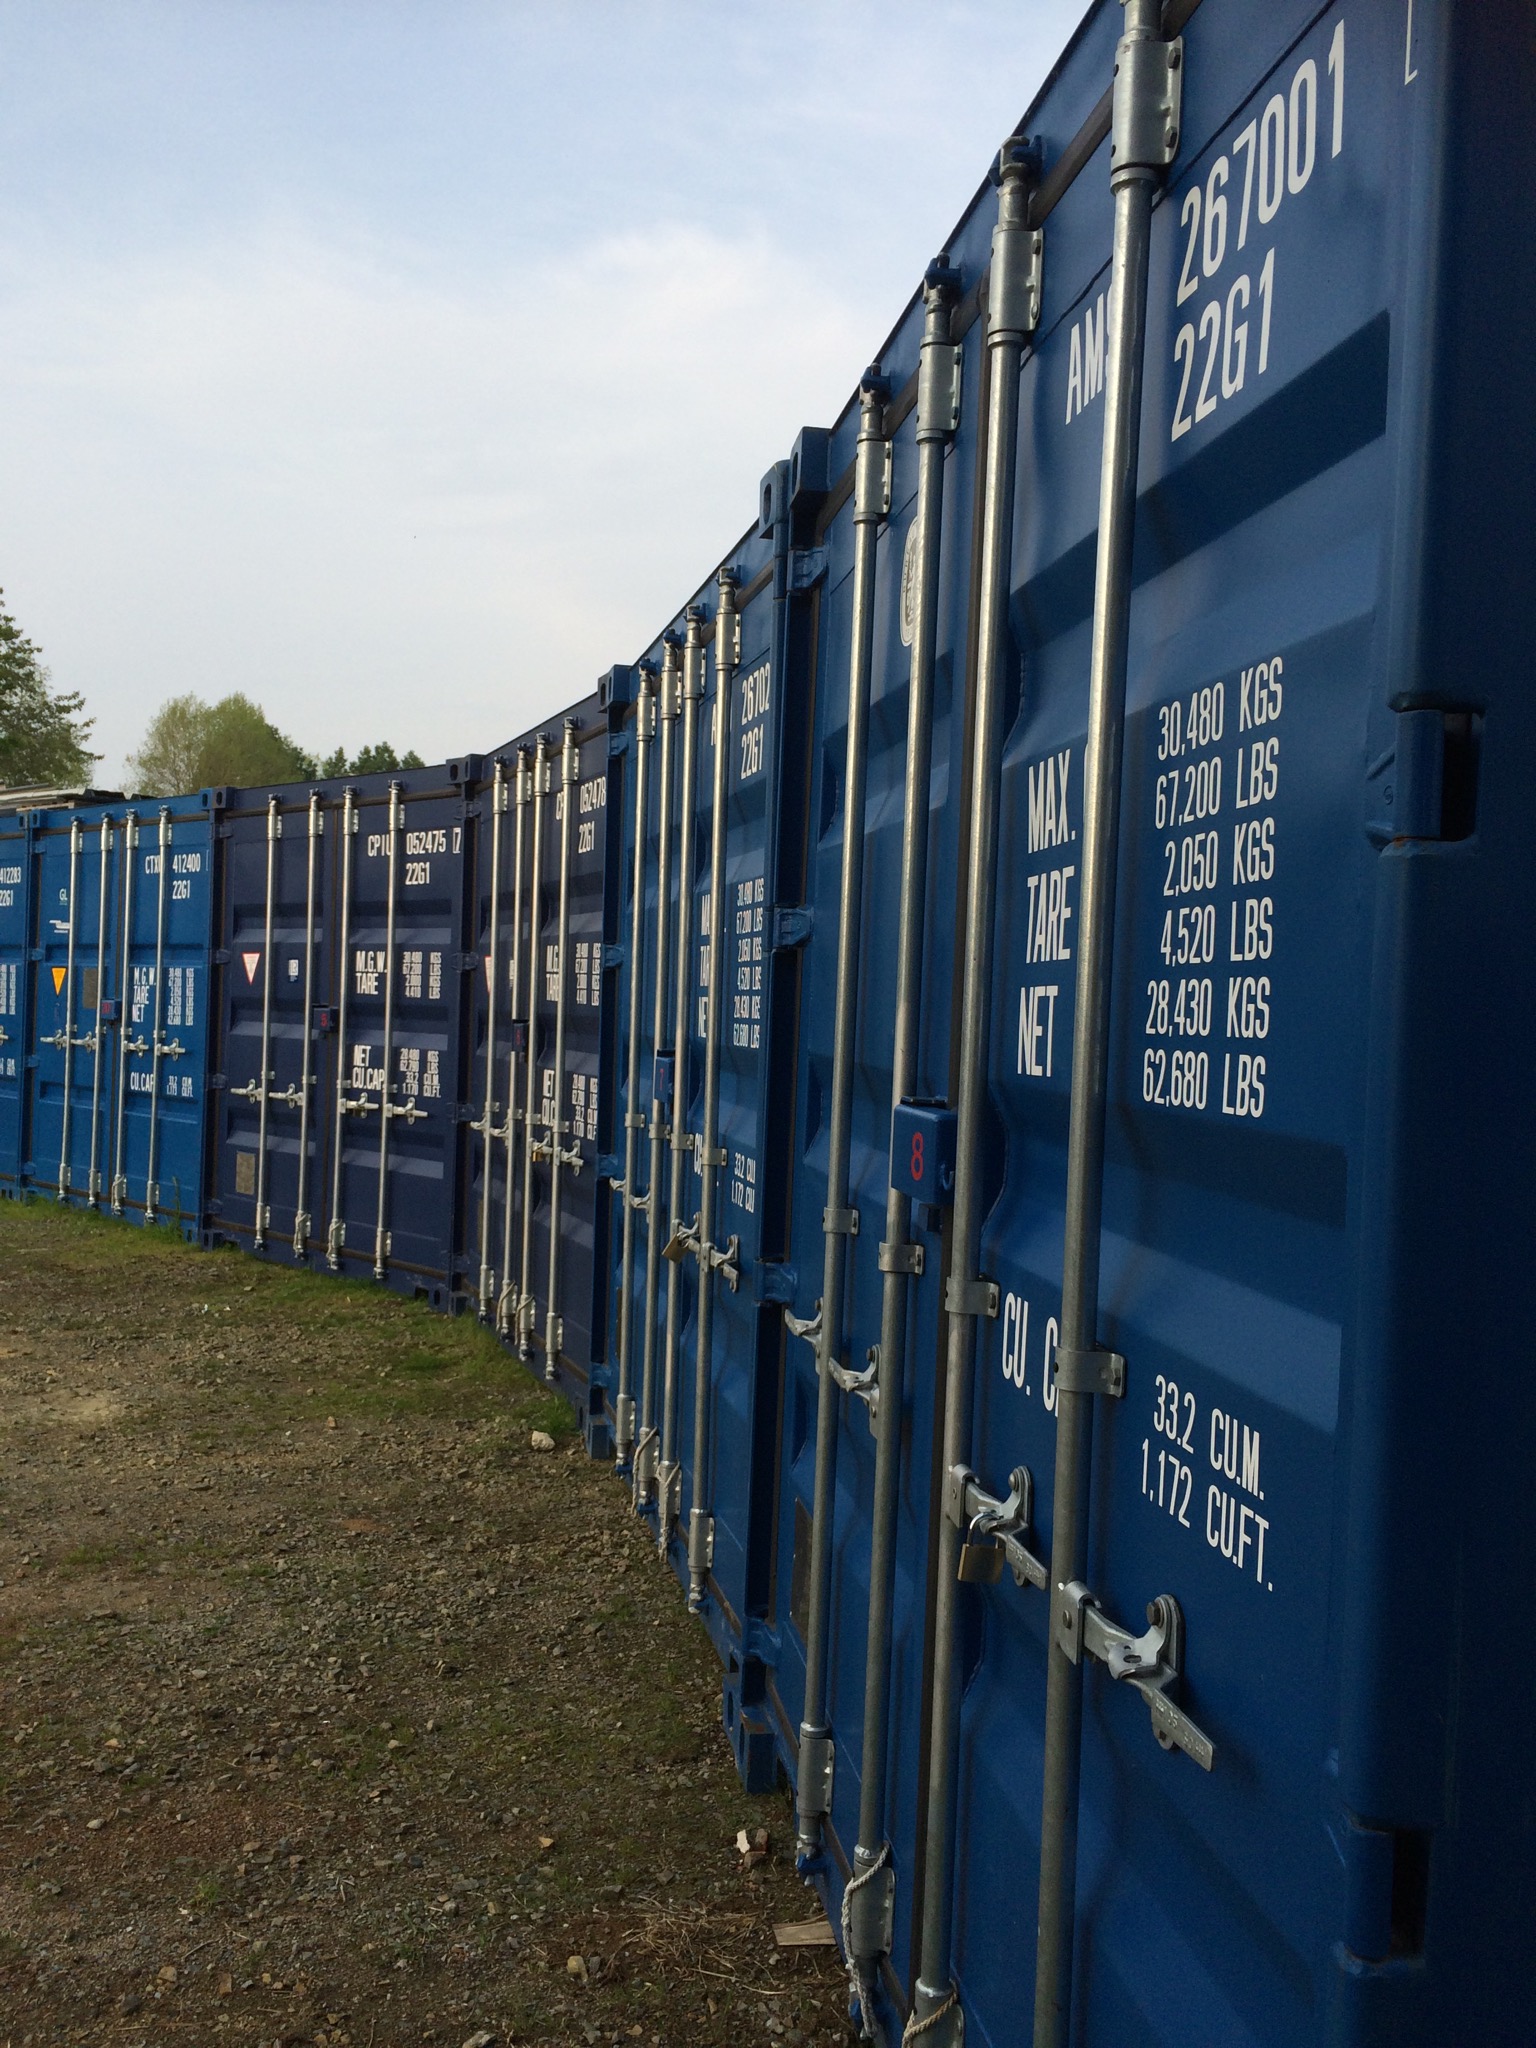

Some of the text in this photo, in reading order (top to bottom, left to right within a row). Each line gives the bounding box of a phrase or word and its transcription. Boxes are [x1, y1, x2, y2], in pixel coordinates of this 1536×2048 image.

[1065, 18, 1344, 425] AM 267001
[1172, 248, 1274, 442] 22G1
[1158, 656, 1283, 760] 30,480 KGS
[741, 724, 764, 779] 22G1
[1155, 737, 1279, 829] 67,200 LBS
[1028, 748, 1075, 854] MAX.
[172, 853, 201, 873] 412400
[406, 829, 446, 855] 052475
[578, 821, 595, 853] 22G1
[1163, 817, 1275, 897] 2,050 KGS
[172, 880, 191, 899] 22G1
[405, 862, 430, 885] 22G1
[1026, 866, 1075, 964] TARE
[1160, 897, 1273, 967] 4,520 LBS
[132, 1004, 145, 1022] NET
[133, 986, 149, 1004] TARE
[356, 973, 379, 995] TARE
[1145, 976, 1271, 1039] 28,430 KGS
[353, 1045, 371, 1067] NET
[1017, 985, 1059, 1077] NET
[1143, 1048, 1266, 1118] 62,680 LBS
[910, 1131, 924, 1181] 8
[1002, 1292, 1030, 1396] CU.
[1153, 1374, 1264, 1500] 33.2 CU.M.
[1142, 1438, 1273, 1592] 1,172 CU.FT.
